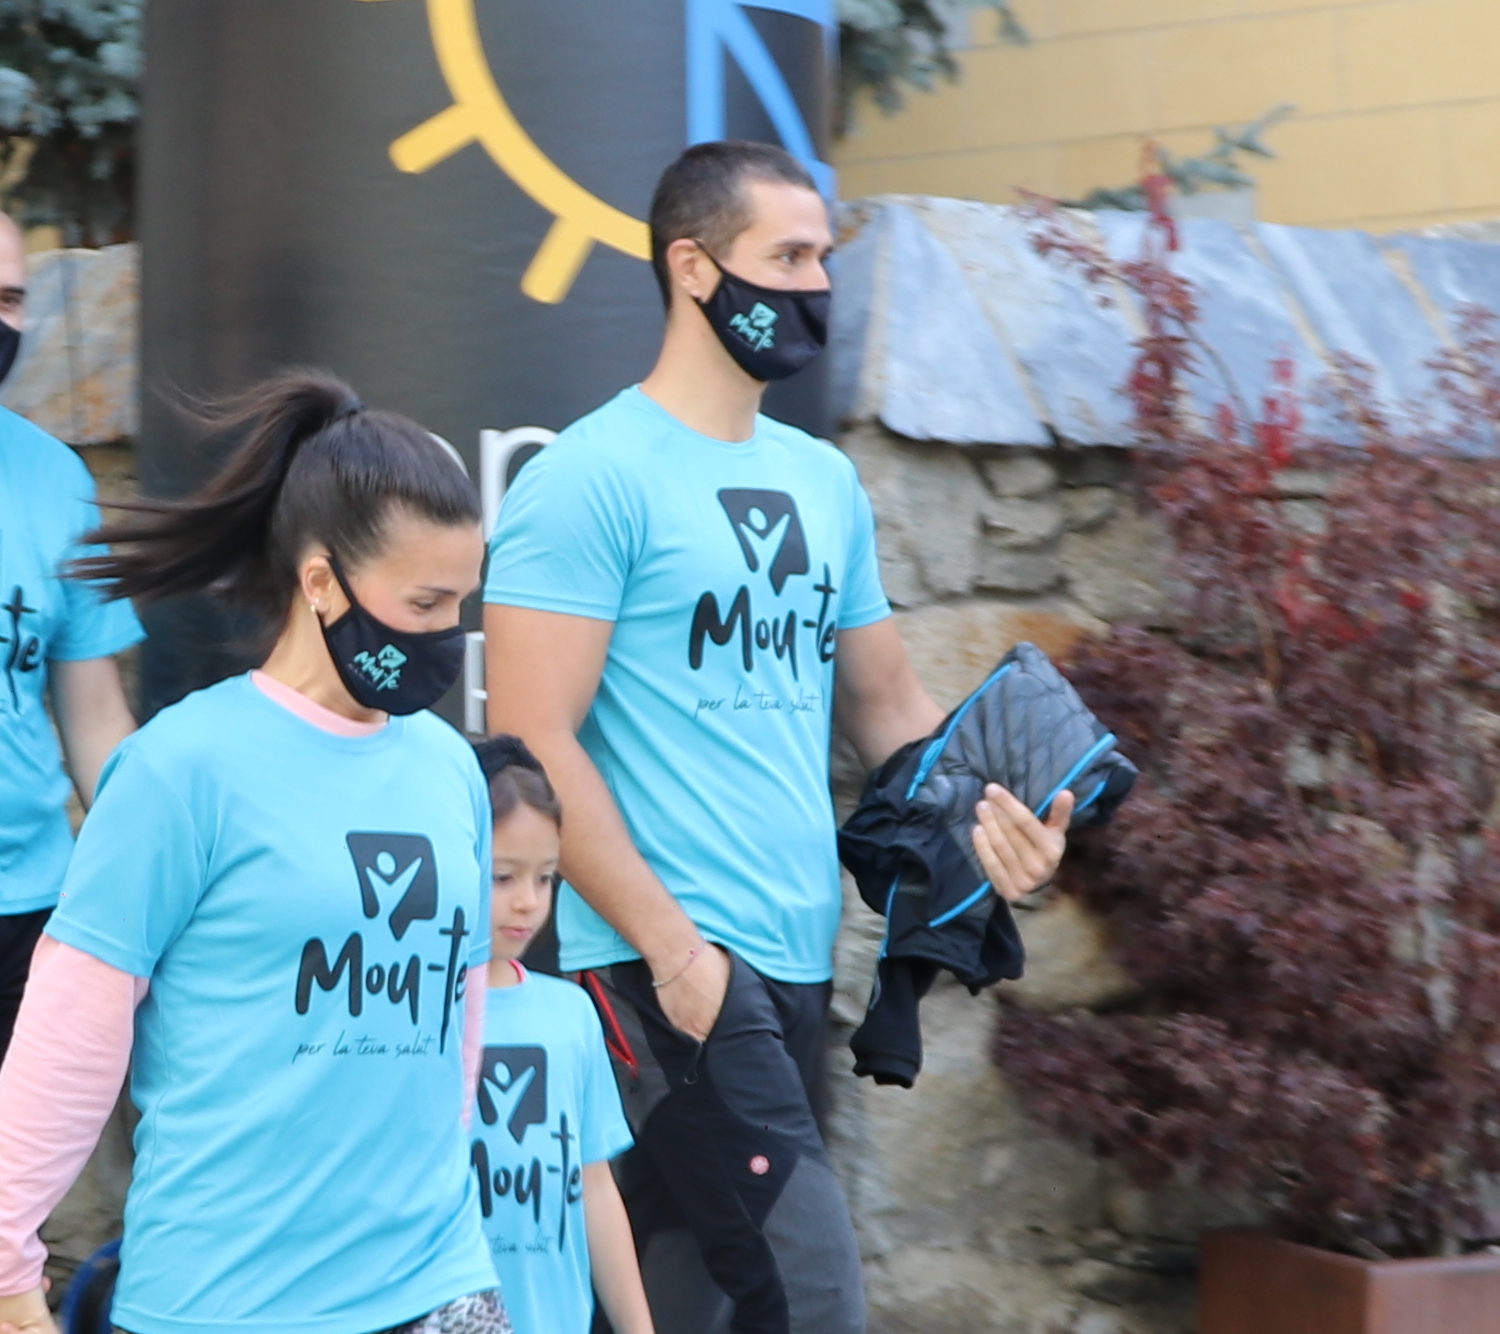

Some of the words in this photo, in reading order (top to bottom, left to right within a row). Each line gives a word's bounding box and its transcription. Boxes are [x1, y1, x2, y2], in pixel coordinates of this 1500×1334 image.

[687, 562, 837, 713] Mou-te
[292, 1041, 327, 1065] per
[333, 1029, 352, 1056] la
[355, 1034, 389, 1056] teva
[295, 905, 470, 1056] Mou-te
